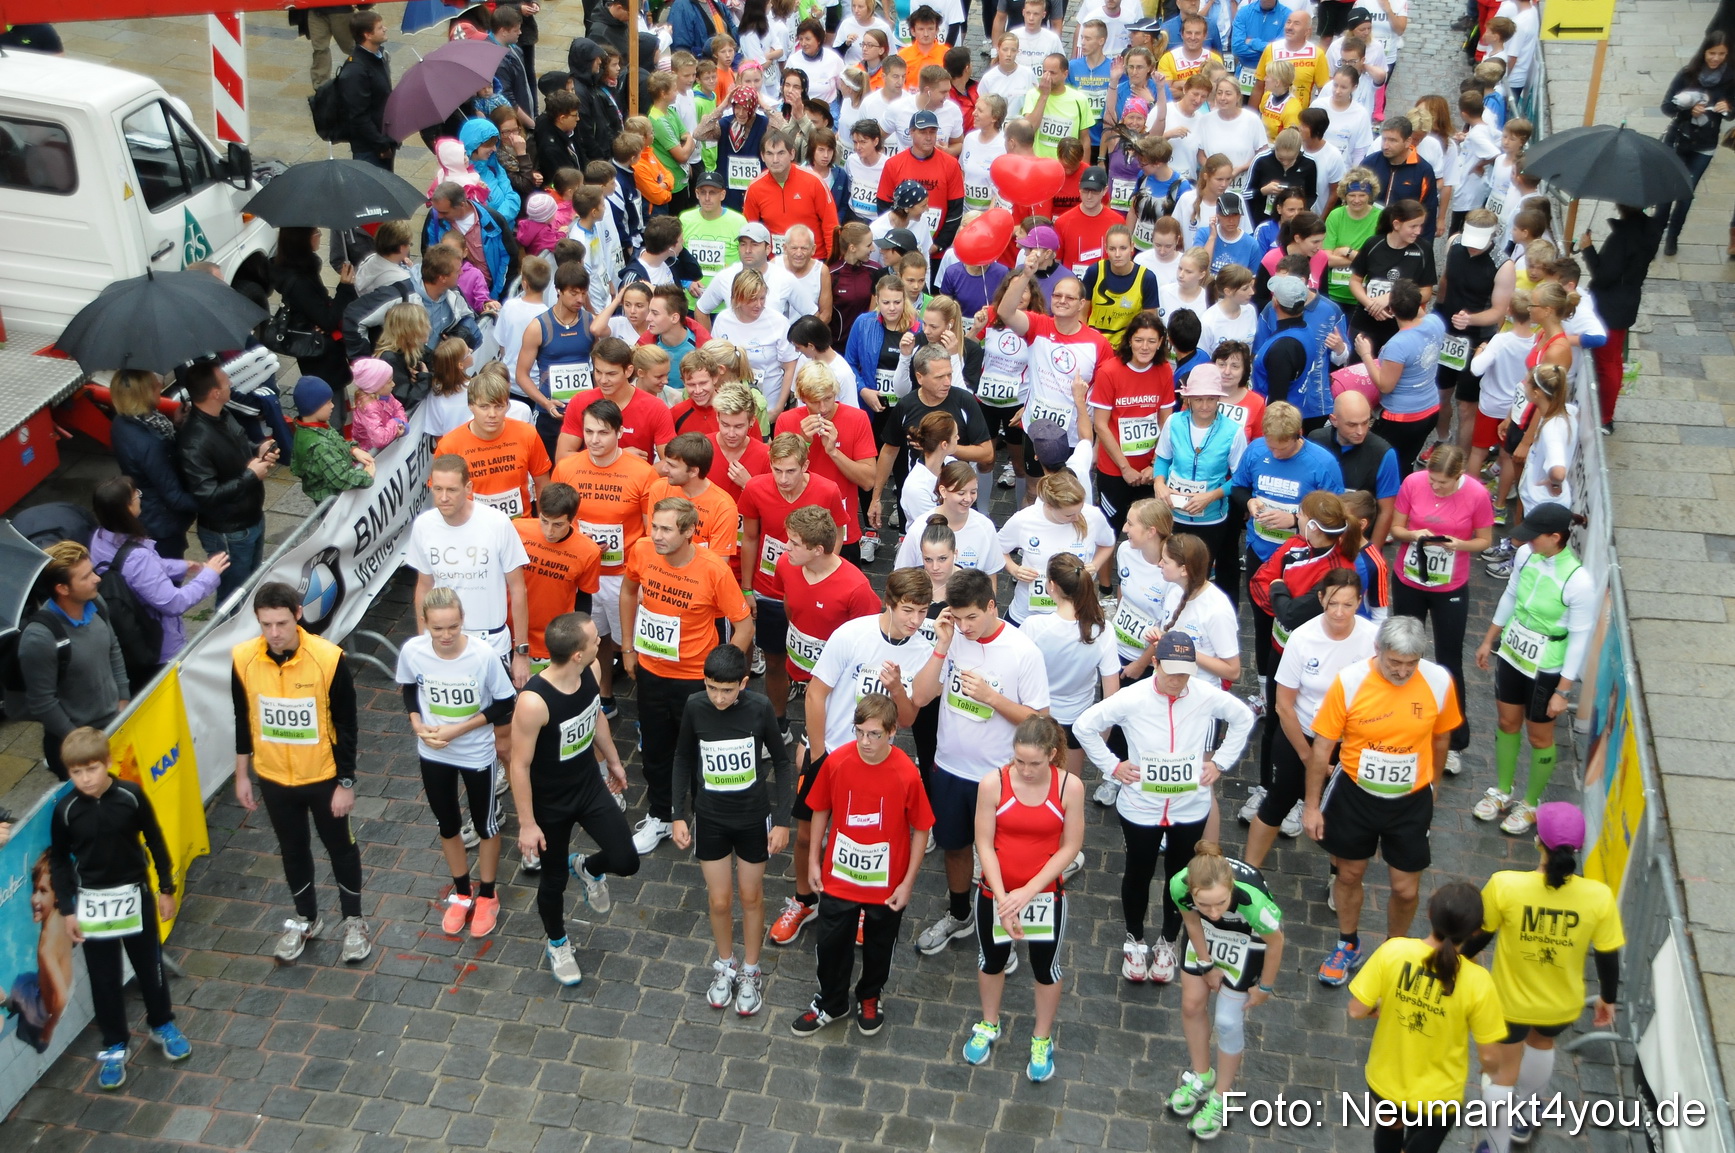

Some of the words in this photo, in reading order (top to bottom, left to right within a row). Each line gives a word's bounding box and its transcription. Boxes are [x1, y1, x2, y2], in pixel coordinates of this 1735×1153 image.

[1042, 121, 1070, 137] 5097
[731, 165, 758, 178] 5185
[852, 187, 877, 204] 2342
[965, 186, 989, 199] 5159
[692, 249, 721, 263] 5032
[555, 373, 589, 390] 5182
[982, 382, 1015, 399] 5120
[1115, 395, 1157, 406] NEUMARKT
[1032, 405, 1066, 428] 5106
[1124, 422, 1158, 441] 5075
[1135, 441, 1150, 450] Anita
[471, 459, 486, 468] WIR
[488, 454, 517, 466] LAUFEN
[489, 463, 516, 475] DAVON
[578, 482, 593, 491] WIR
[594, 483, 623, 493] LAUFEN
[1258, 474, 1300, 492] HUBER
[579, 491, 593, 500] CHT
[594, 493, 621, 502] DAVON
[353, 468, 404, 558] BMW
[353, 521, 409, 589] Weniger
[430, 546, 459, 566] BC
[466, 546, 489, 567] 93
[1408, 550, 1448, 573] 501
[540, 559, 570, 573] LAUFEN
[433, 569, 488, 582] Neumarkt
[538, 569, 565, 581] DAVON
[658, 567, 700, 586] Running-Team
[647, 578, 661, 591] WIR
[662, 584, 694, 601] LAUFEN
[661, 594, 689, 610] DAVON
[640, 618, 675, 644] 5087
[1117, 609, 1146, 640] 5041
[789, 634, 822, 660] 5153
[1506, 629, 1539, 660] 5040
[860, 667, 879, 676] PARTL
[430, 687, 474, 706] 5190
[957, 698, 980, 714] Tobias
[264, 708, 311, 727] 5099
[272, 729, 305, 739] Matthias
[566, 711, 598, 744] 5071
[717, 744, 745, 752] Neumarkt
[1367, 741, 1413, 753] WERNER
[706, 751, 752, 773] 5096
[1141, 755, 1160, 763] PARTL
[715, 775, 746, 785] Dominik
[1147, 763, 1193, 783] 5050
[1364, 763, 1412, 783] 5152
[1155, 785, 1184, 793] Claudia
[852, 844, 880, 854] Neumarkt
[838, 846, 884, 871] 5057
[849, 871, 868, 881] Leon
[86, 897, 136, 918] 5172
[1520, 905, 1580, 937] MTP
[1519, 932, 1575, 948] Hersbruck
[1395, 988, 1447, 1018] Hersbruck
